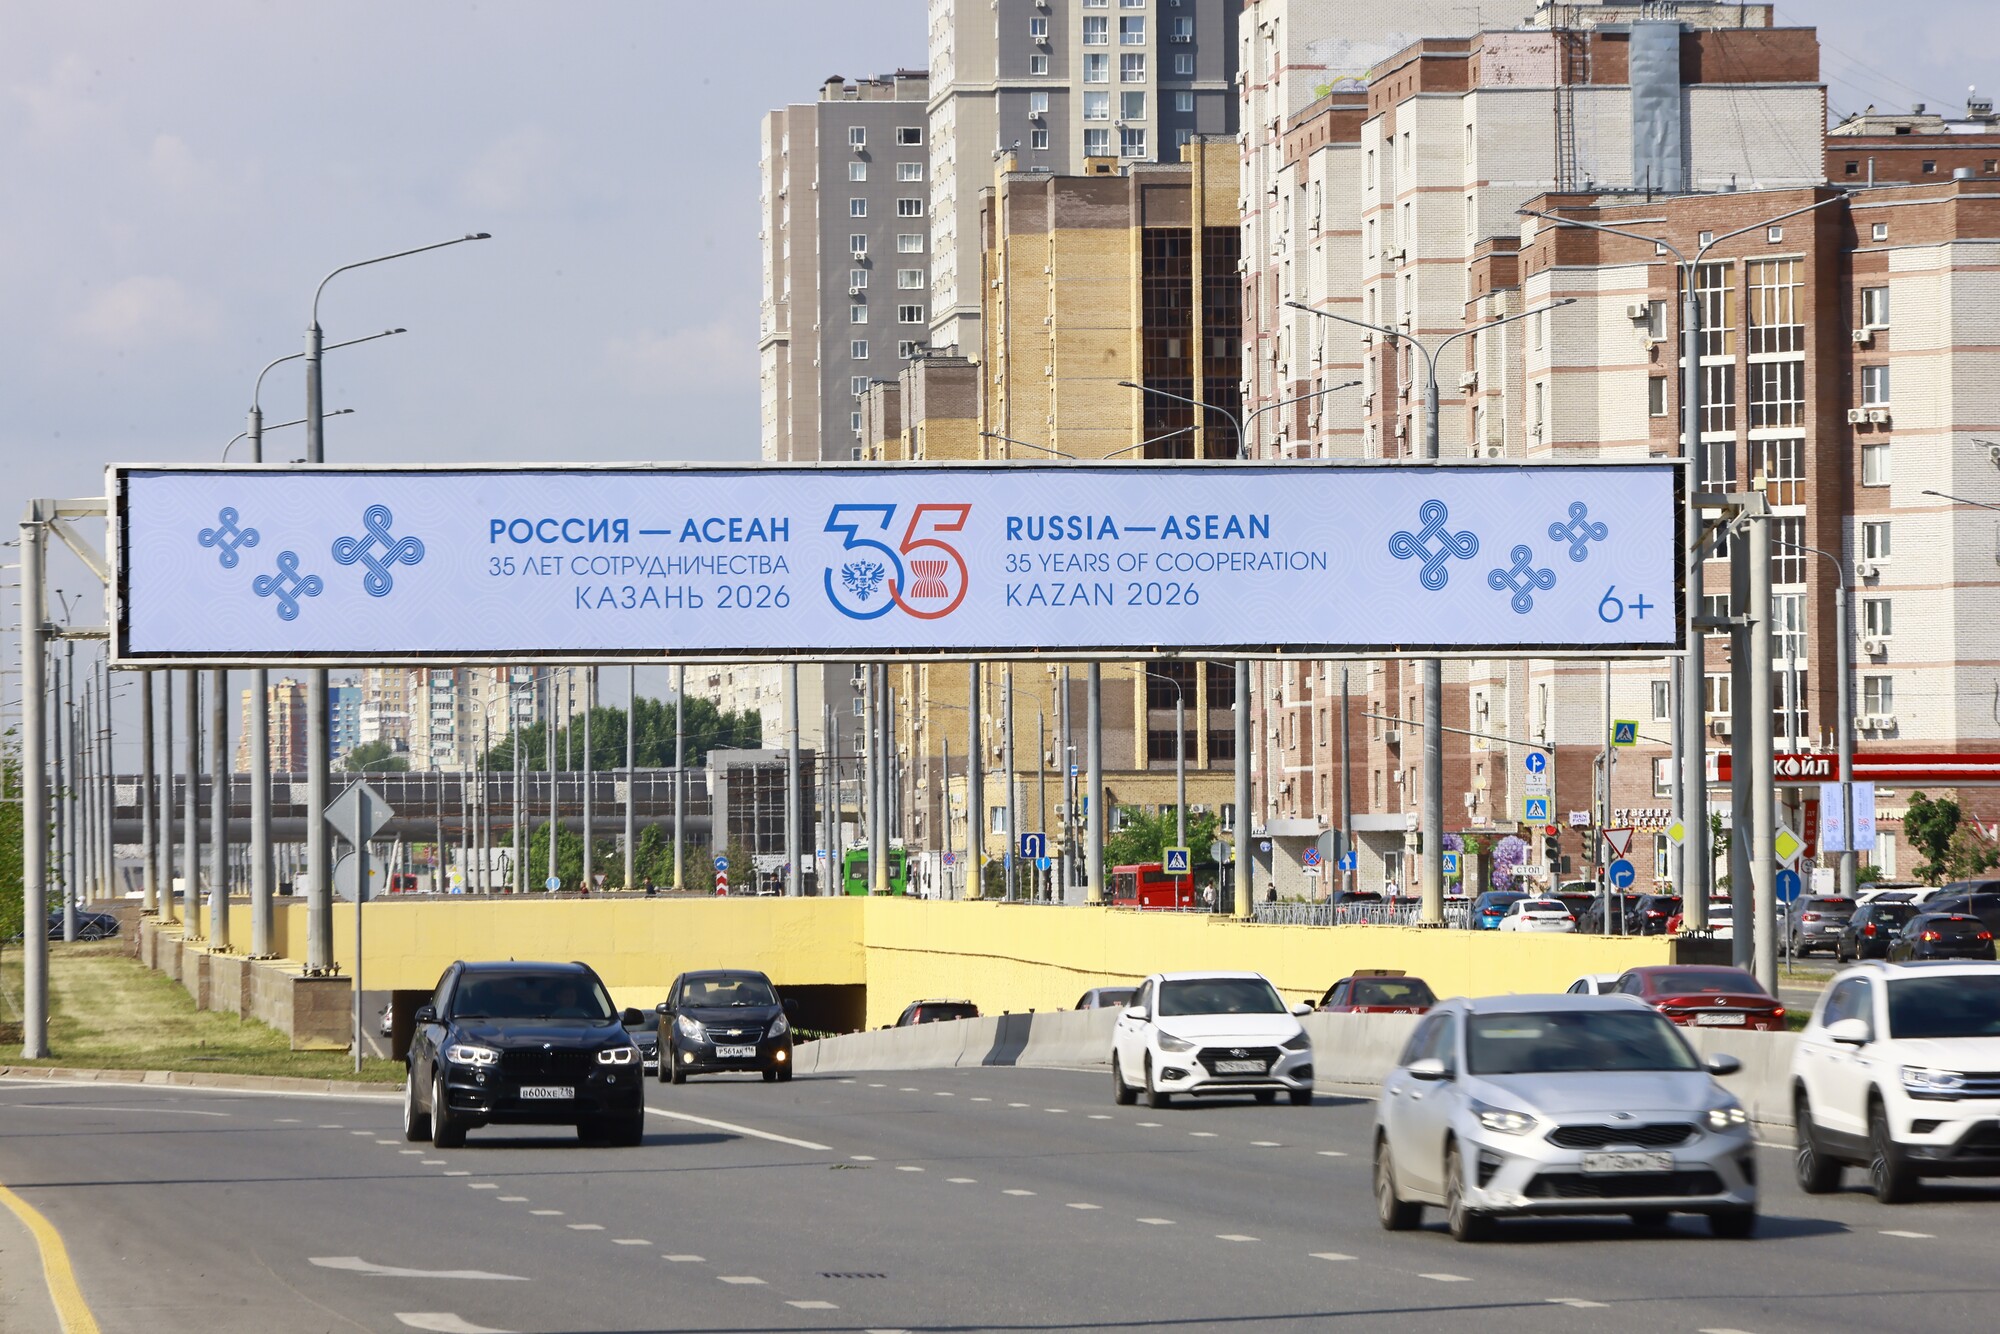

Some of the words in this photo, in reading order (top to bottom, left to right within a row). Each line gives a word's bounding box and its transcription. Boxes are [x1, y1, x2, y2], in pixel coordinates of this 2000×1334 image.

[490, 518, 629, 544] РОССИЯ
[679, 517, 789, 543] АСЕАН
[489, 557, 516, 576] 35
[522, 556, 564, 575] ЛЕТ
[571, 555, 790, 578] СОТРУДНИЧЕСТВА
[823, 504, 972, 620] 35
[1005, 554, 1032, 573] 35
[1038, 553, 1110, 572] YEARS
[1117, 552, 1148, 572] OF
[1155, 551, 1327, 572] COOPERATION
[576, 586, 704, 609] КАЗАНЬ
[717, 584, 790, 608] 2026
[1006, 583, 1113, 606] KAZAN
[1127, 582, 1200, 606] 2026
[1598, 584, 1654, 624] 6+
[1774, 756, 1830, 777] КОЙЛ
[1614, 808, 1673, 818] СУВЕНИР
[1634, 817, 1672, 826] ИТАЛИ
[1516, 866, 1540, 874] СТОП
[522, 1087, 558, 1098] В600ХЕ
